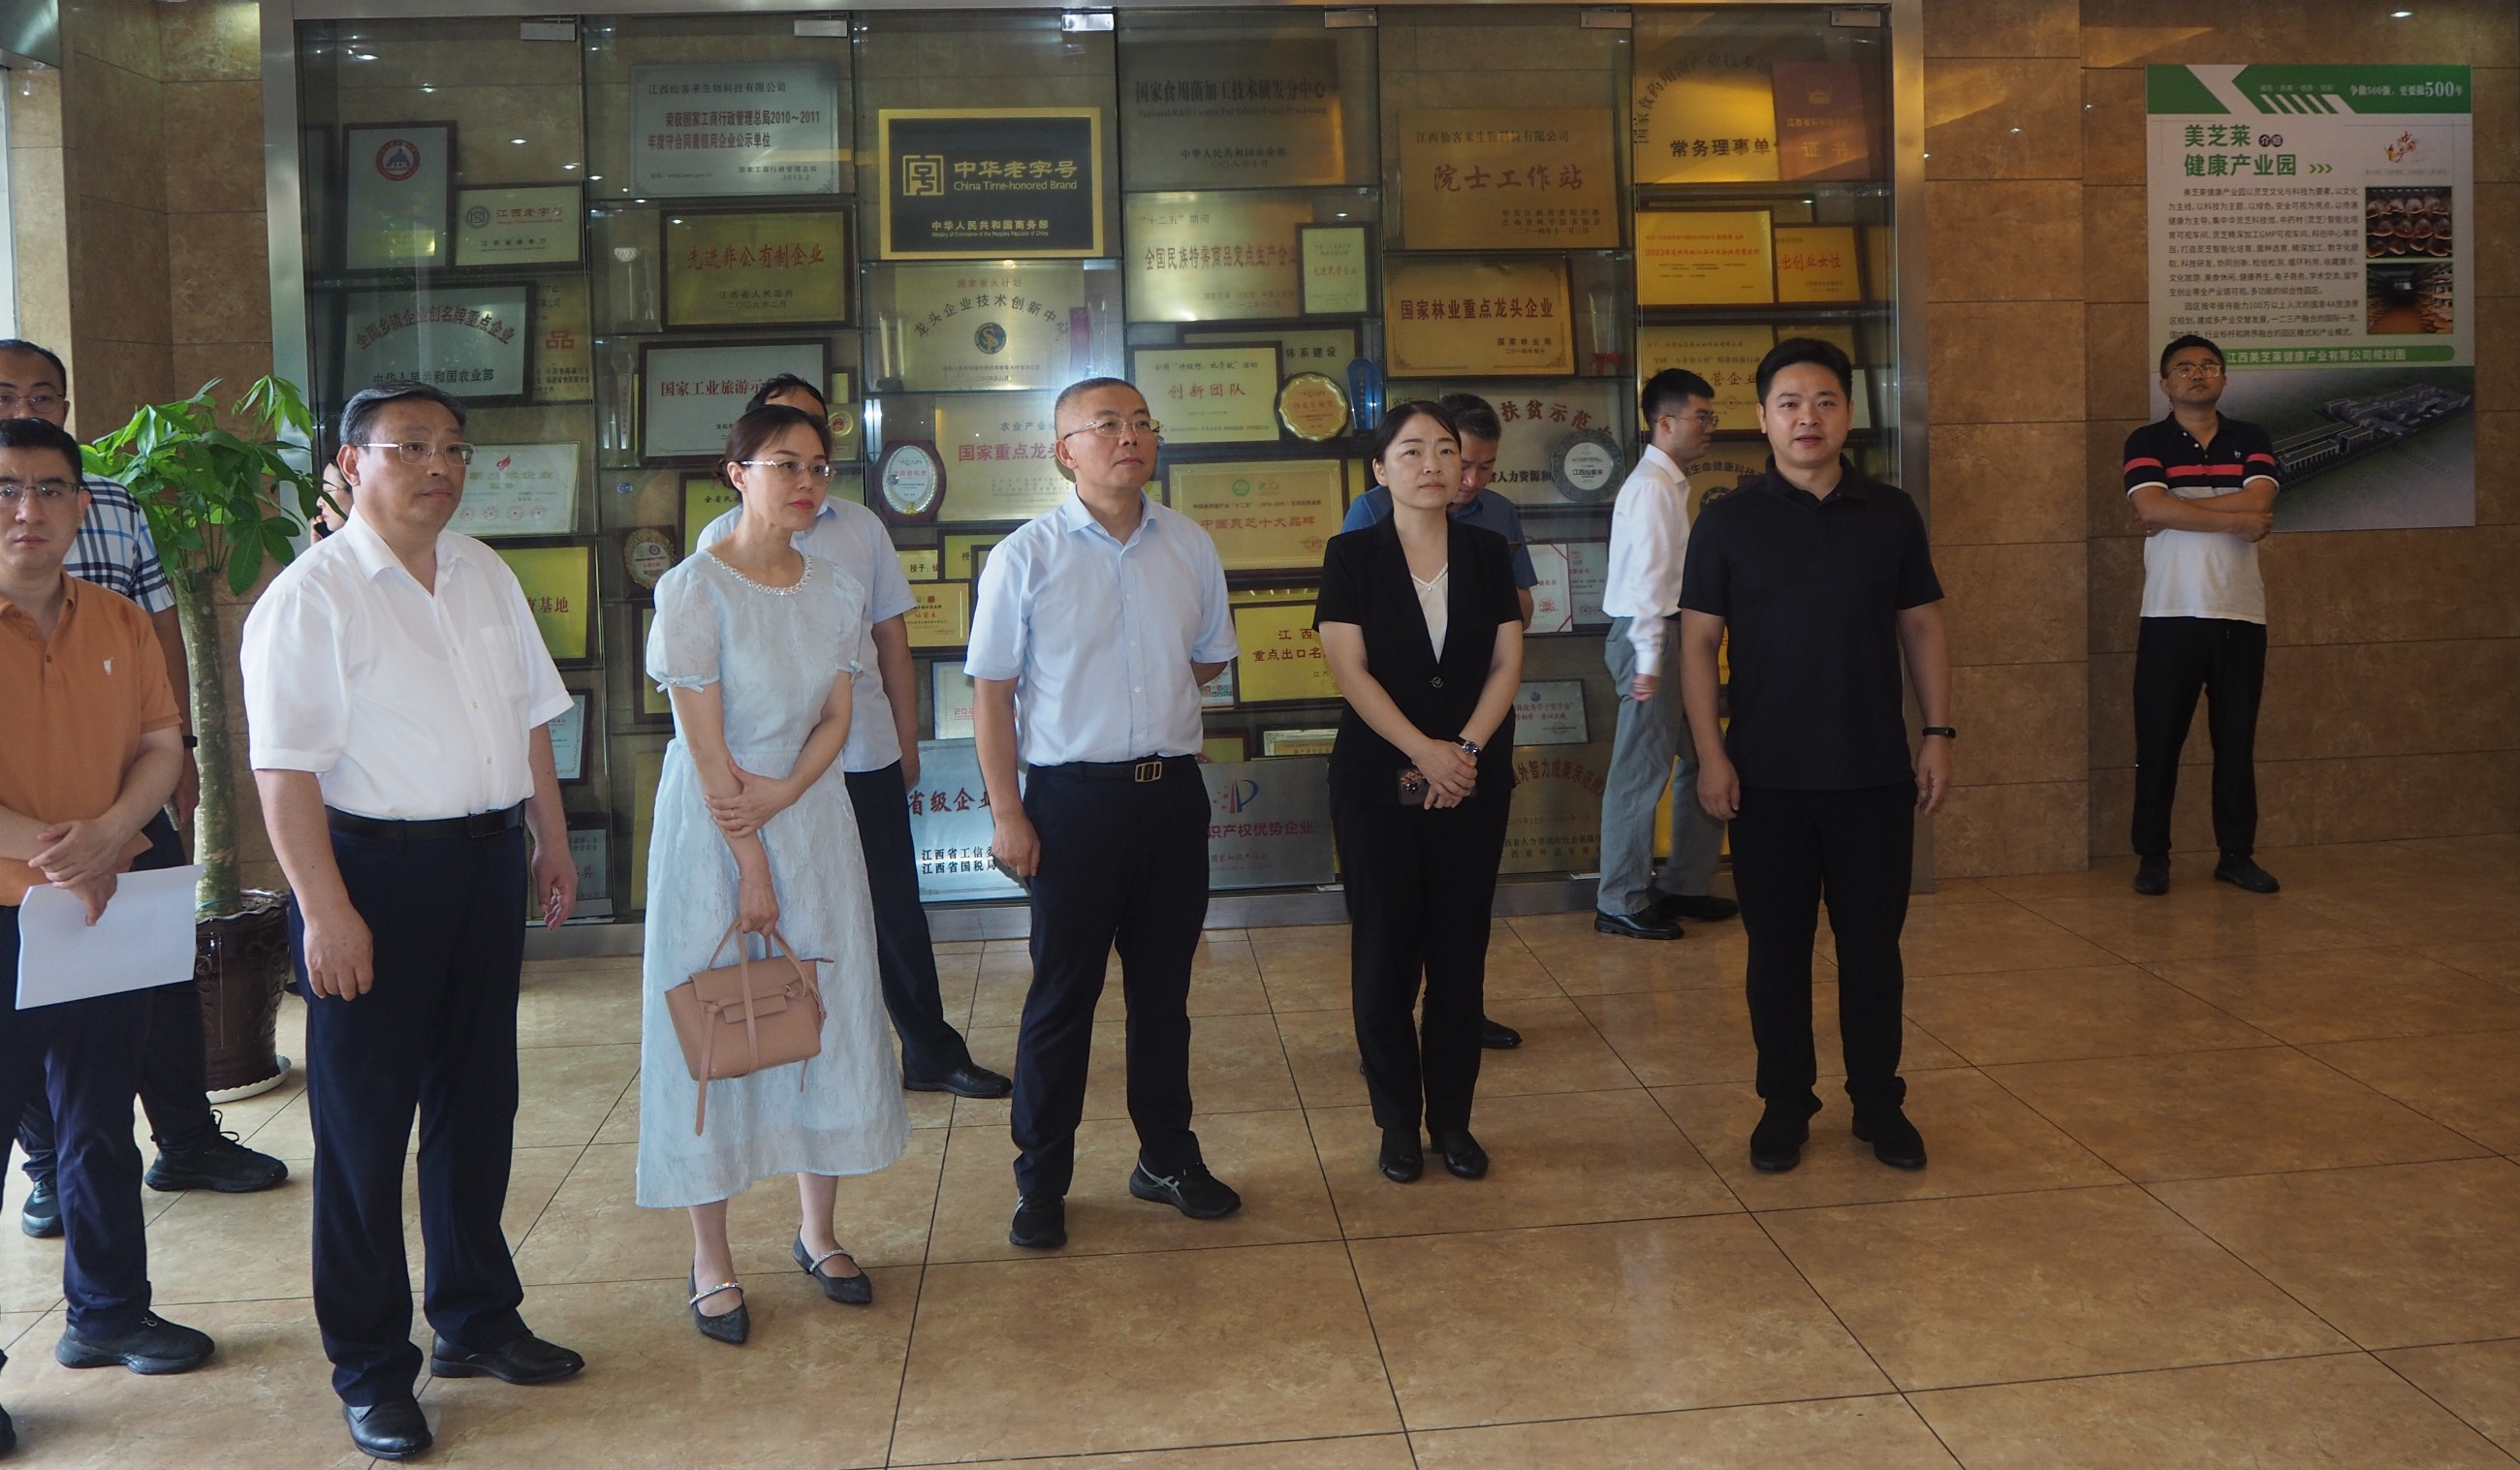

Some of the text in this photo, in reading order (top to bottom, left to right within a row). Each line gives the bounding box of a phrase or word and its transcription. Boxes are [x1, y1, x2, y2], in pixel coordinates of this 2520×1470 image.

[2184, 124, 2251, 147] 美芝莱
[1670, 138, 1778, 158] 常务理事单
[954, 160, 1078, 178] 中华老字号
[2184, 153, 2298, 176] 健康产业园
[954, 180, 1078, 191] China Time-honored Brand
[1433, 163, 1585, 192] 院士工作站
[931, 219, 1050, 231] 中华人民共和国商务部
[686, 243, 824, 270] 先进非公有制企业
[1777, 252, 1843, 270] 出创业女性
[957, 278, 1023, 288] 国家星火计划
[914, 293, 1070, 339] 龙头企业技术创新中心
[1401, 297, 1554, 321] 国家林业重点龙头企业
[356, 305, 516, 349] 全国乡镇企业创名牌重点企业
[1285, 346, 1338, 359] 体系建设
[1695, 370, 1757, 388] 营企业
[1167, 383, 1246, 399] 创新团队
[1500, 399, 1613, 436] 扶贫示范
[1277, 628, 1312, 641] 江西
[1252, 647, 1327, 662] 重点出口名
[921, 846, 993, 861] 江西省工信委
[922, 860, 996, 875] 江西省国税局
